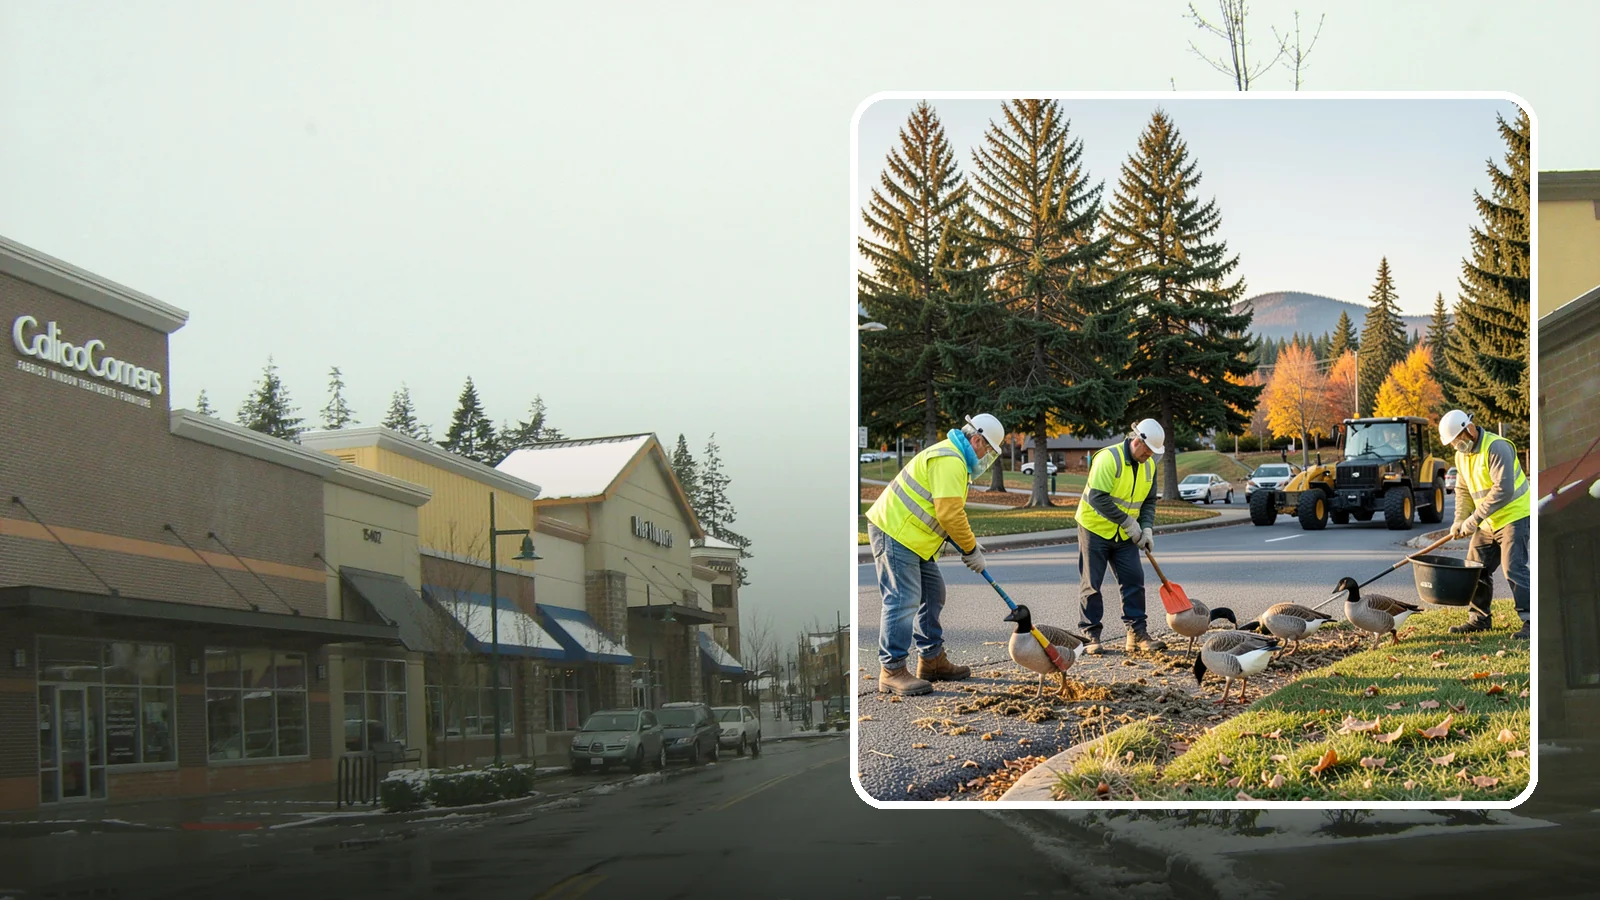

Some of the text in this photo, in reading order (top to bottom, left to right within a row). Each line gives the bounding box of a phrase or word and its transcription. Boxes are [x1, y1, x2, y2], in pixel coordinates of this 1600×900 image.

[17, 360, 151, 408] FABRICS WINDOW TREATMENTS FURNITURE
